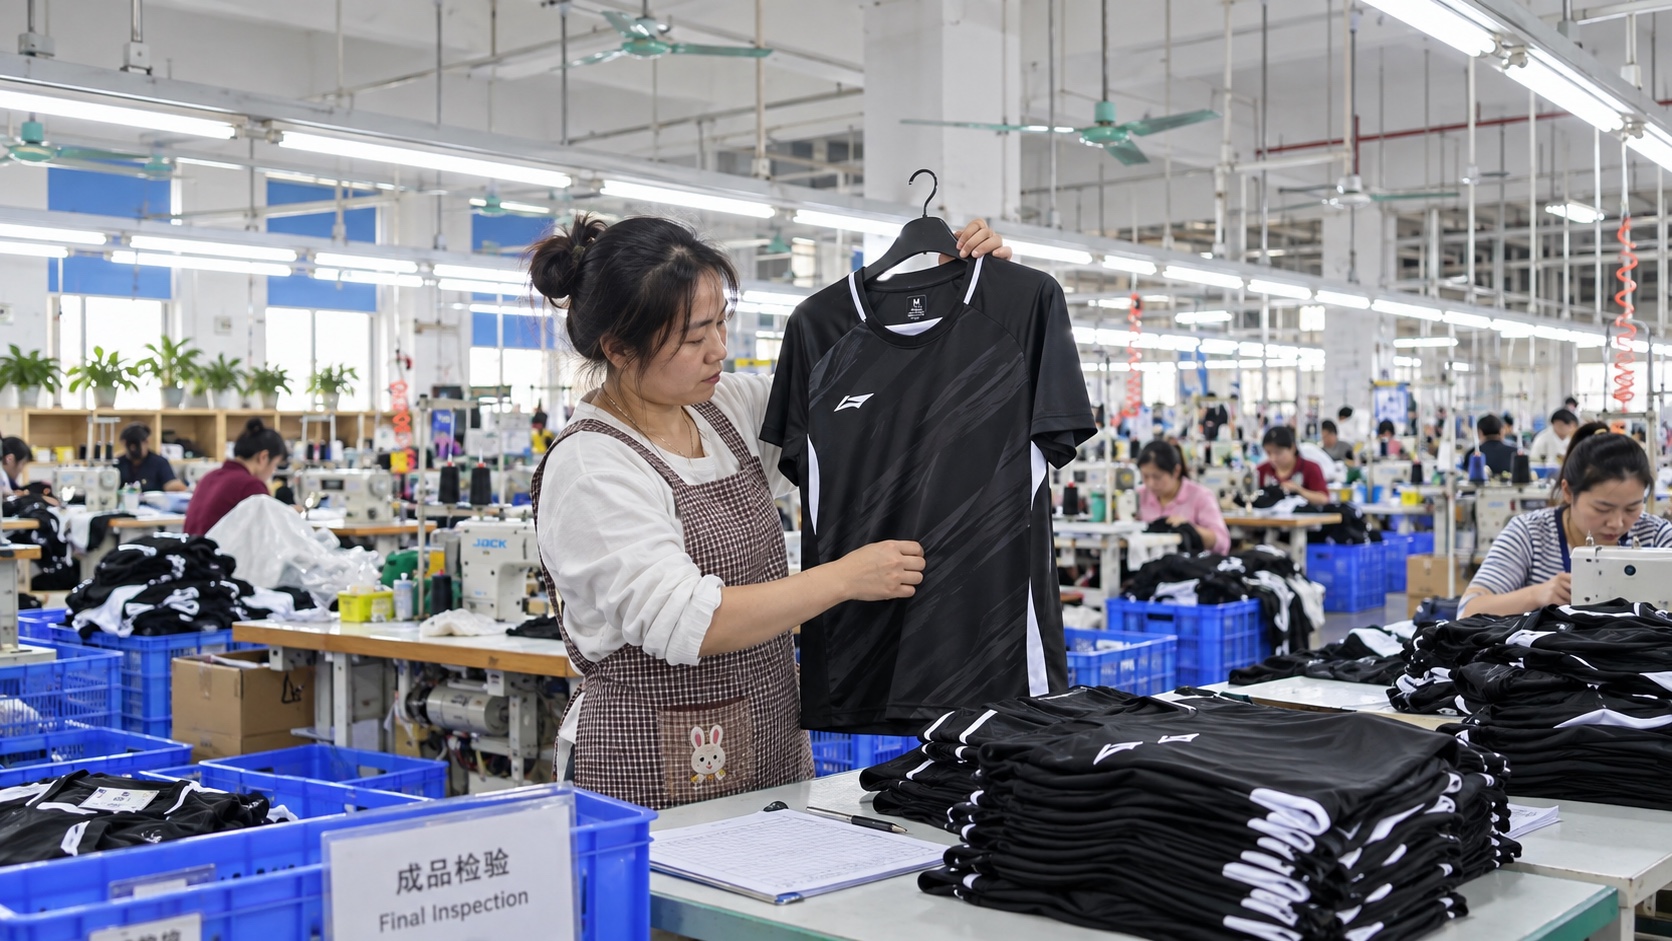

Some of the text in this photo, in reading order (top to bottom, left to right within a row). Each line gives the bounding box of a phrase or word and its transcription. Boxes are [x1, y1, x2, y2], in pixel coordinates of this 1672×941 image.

[913, 298, 920, 306] M
[396, 848, 510, 895] 成品检验
[379, 890, 529, 932] Final Inspection
